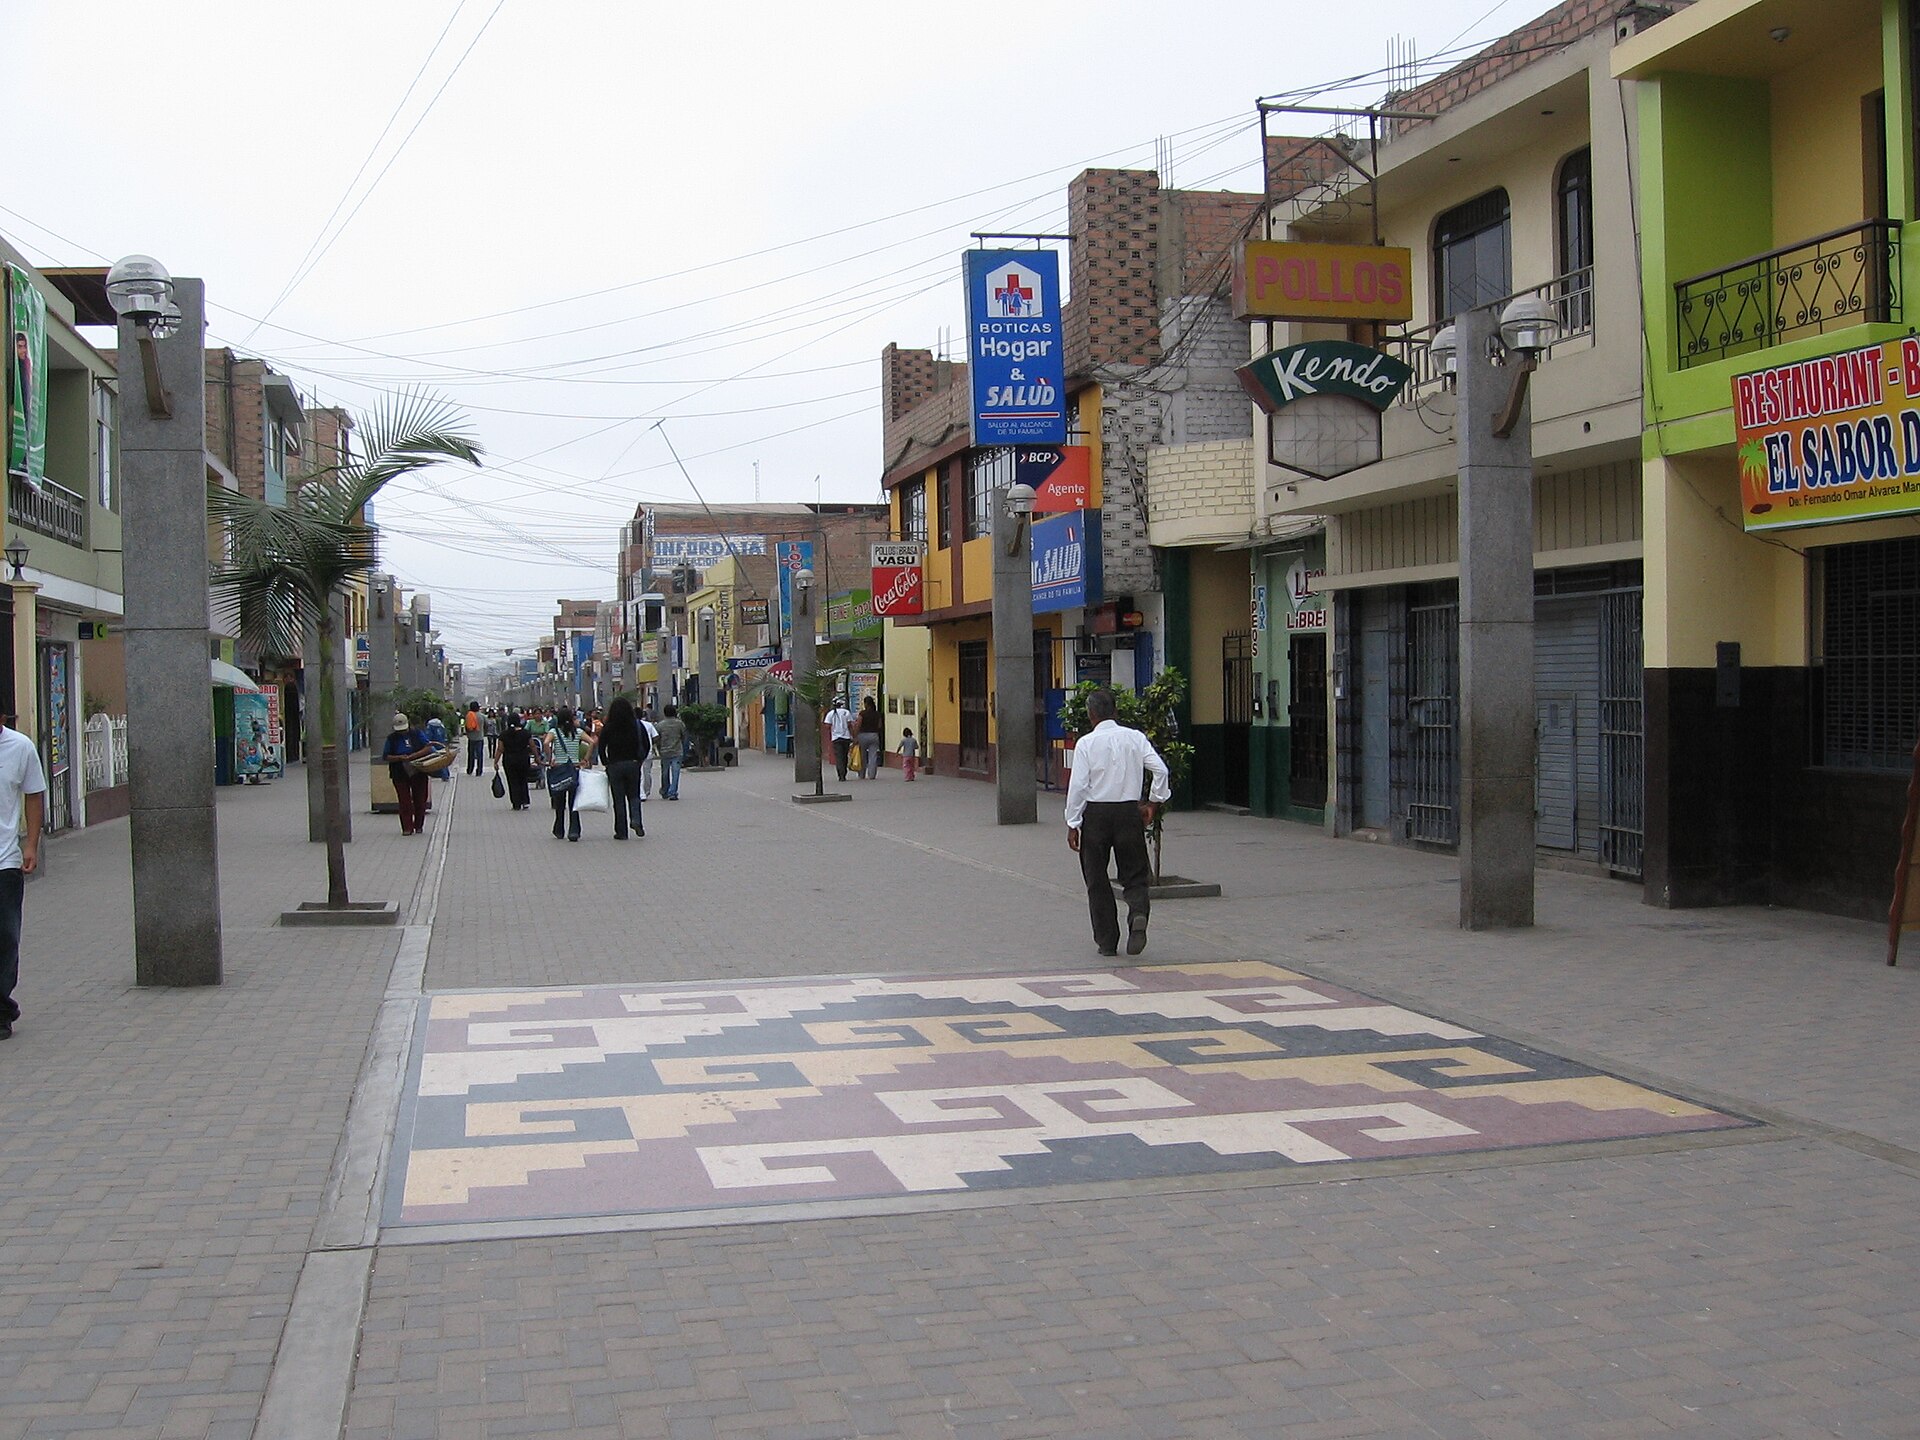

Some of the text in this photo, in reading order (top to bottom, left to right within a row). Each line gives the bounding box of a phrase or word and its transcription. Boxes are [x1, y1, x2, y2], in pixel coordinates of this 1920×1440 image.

[1255, 256, 1404, 304] POLLOS
[980, 323, 1052, 333] BOTICAS
[980, 336, 1052, 362] Hogar
[1010, 367, 1025, 380] &
[1271, 348, 1396, 401] Kendo
[985, 385, 1055, 407] SALUD
[1737, 346, 1884, 430] RESTAURANT
[1029, 452, 1051, 463] BCP
[1764, 431, 1800, 493] EL
[1801, 414, 1899, 491] SABOR
[1047, 483, 1085, 497] Agente
[1788, 496, 1802, 507] De:
[1804, 490, 1842, 506] Fernando
[1844, 489, 1866, 501] Omar
[1868, 484, 1901, 498] Alvarez
[878, 556, 915, 565] YASU
[1043, 543, 1081, 582] SALUD
[1257, 587, 1266, 630] FAX
